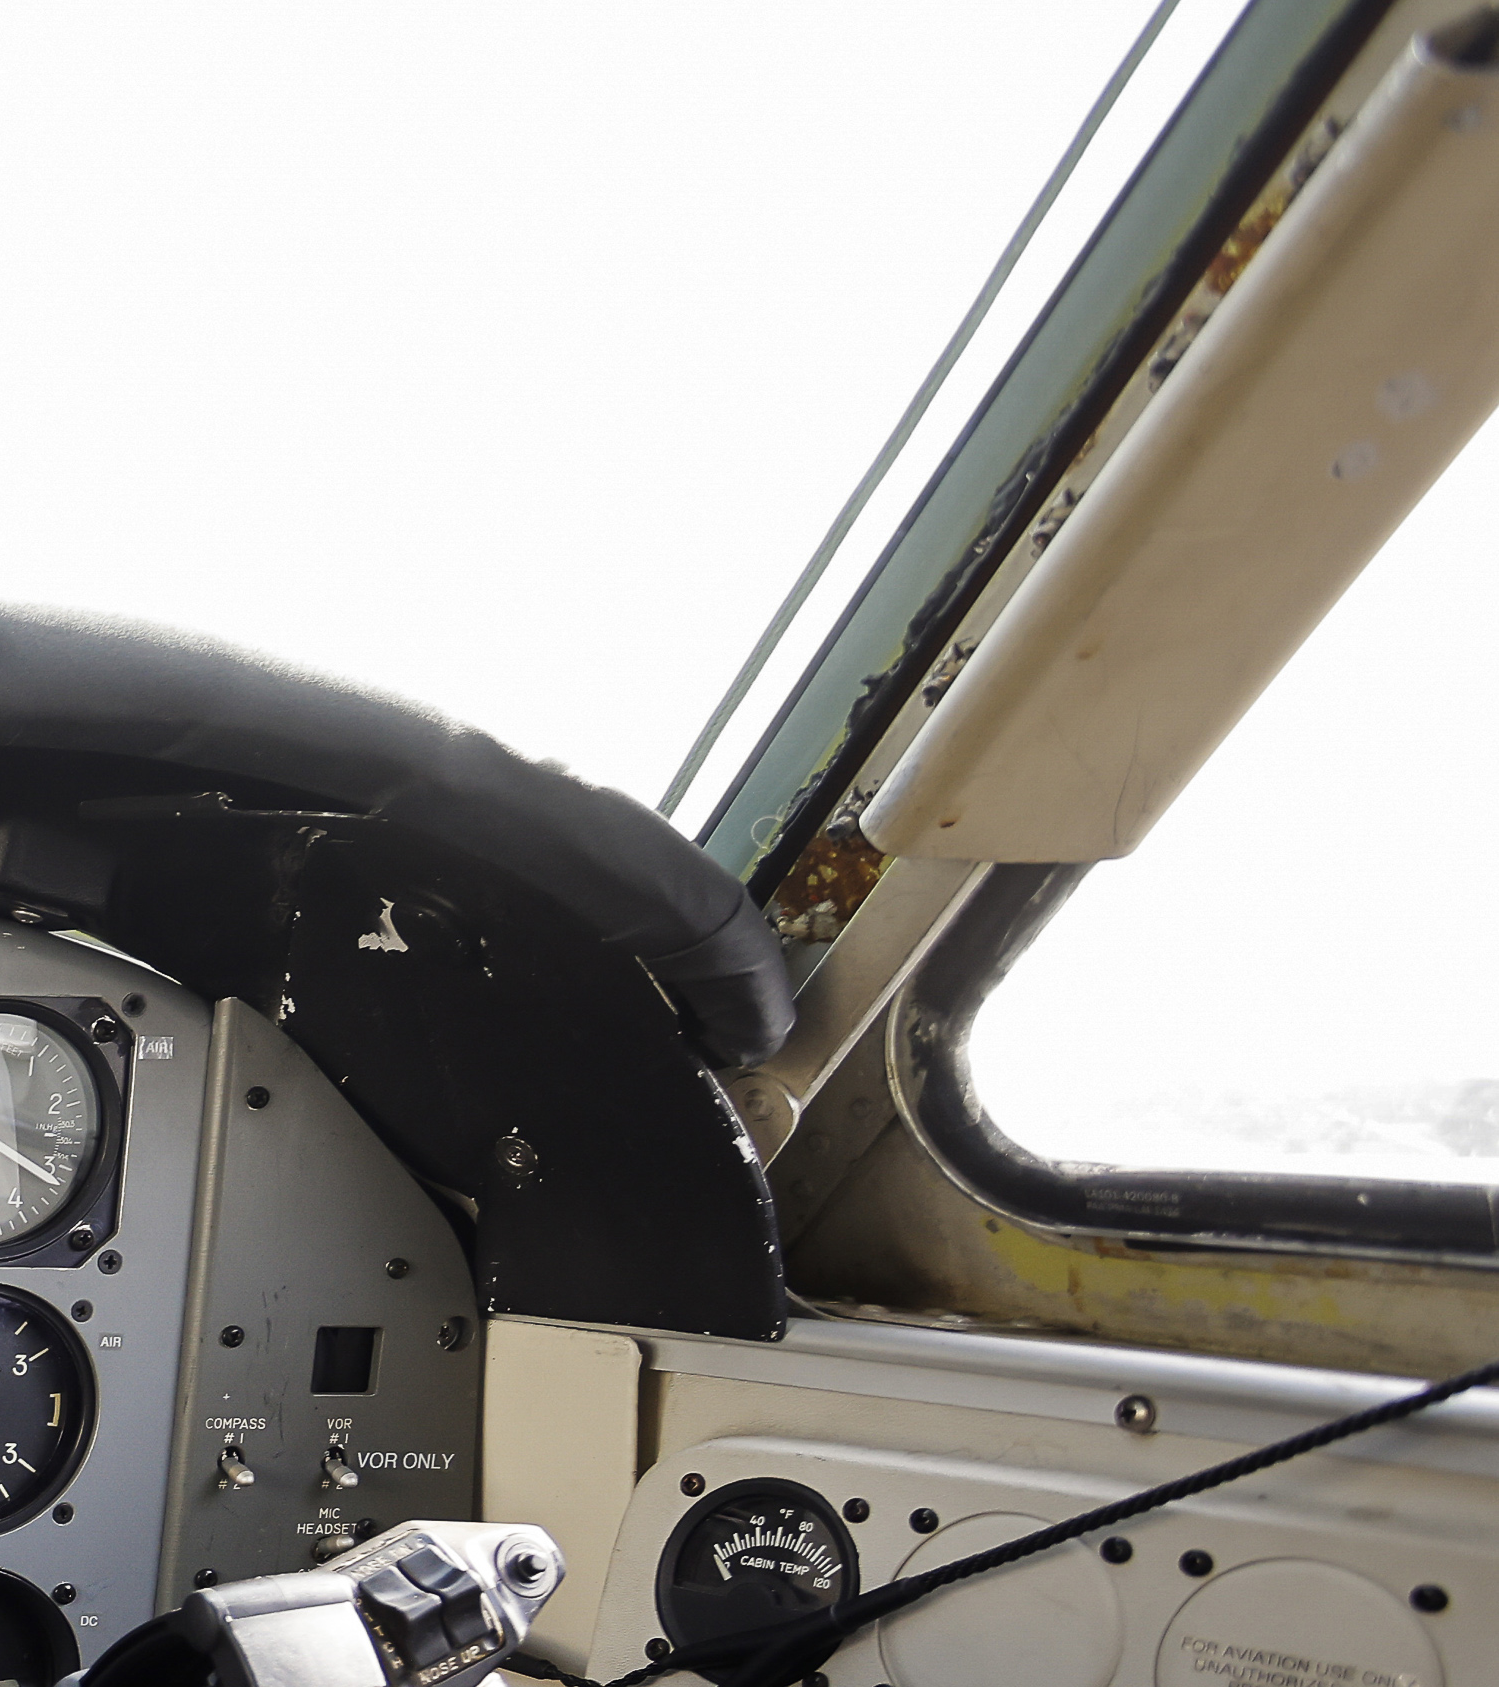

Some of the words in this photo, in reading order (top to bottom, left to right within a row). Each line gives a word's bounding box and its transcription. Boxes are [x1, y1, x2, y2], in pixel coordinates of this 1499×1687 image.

[205, 1417, 266, 1431] COMPASS
[357, 1452, 399, 1470] VOR
[402, 1453, 455, 1472] ONLY
[740, 1556, 775, 1569] CABIN
[780, 1562, 809, 1575] TEMP
